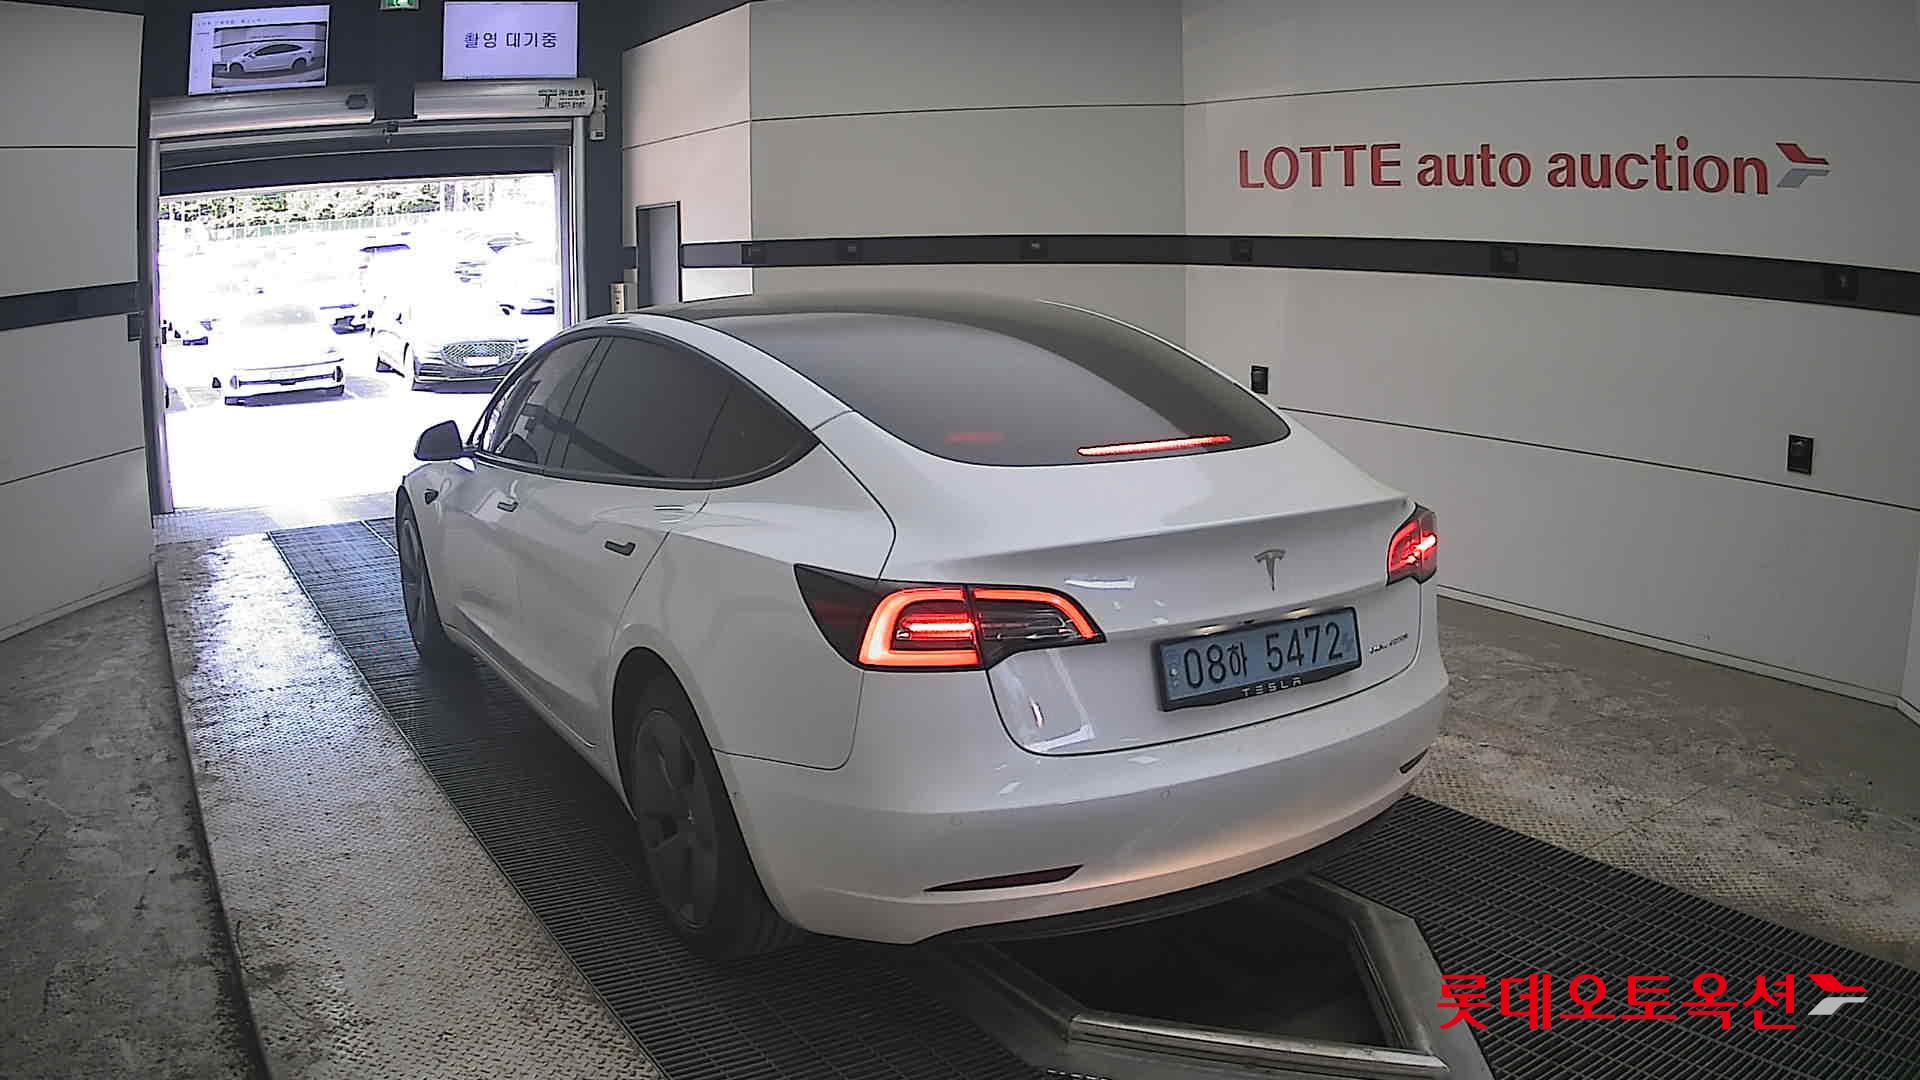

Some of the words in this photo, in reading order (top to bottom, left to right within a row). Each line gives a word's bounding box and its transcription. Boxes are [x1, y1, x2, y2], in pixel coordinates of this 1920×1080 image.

[506, 32, 558, 48] 대기중
[1239, 145, 1400, 190] LOTTE
[1416, 144, 1532, 188] auto
[1546, 136, 1770, 194] auction
[1184, 643, 1247, 689] 08하
[1265, 622, 1344, 672] 5472
[1242, 677, 1302, 697] TESLA
